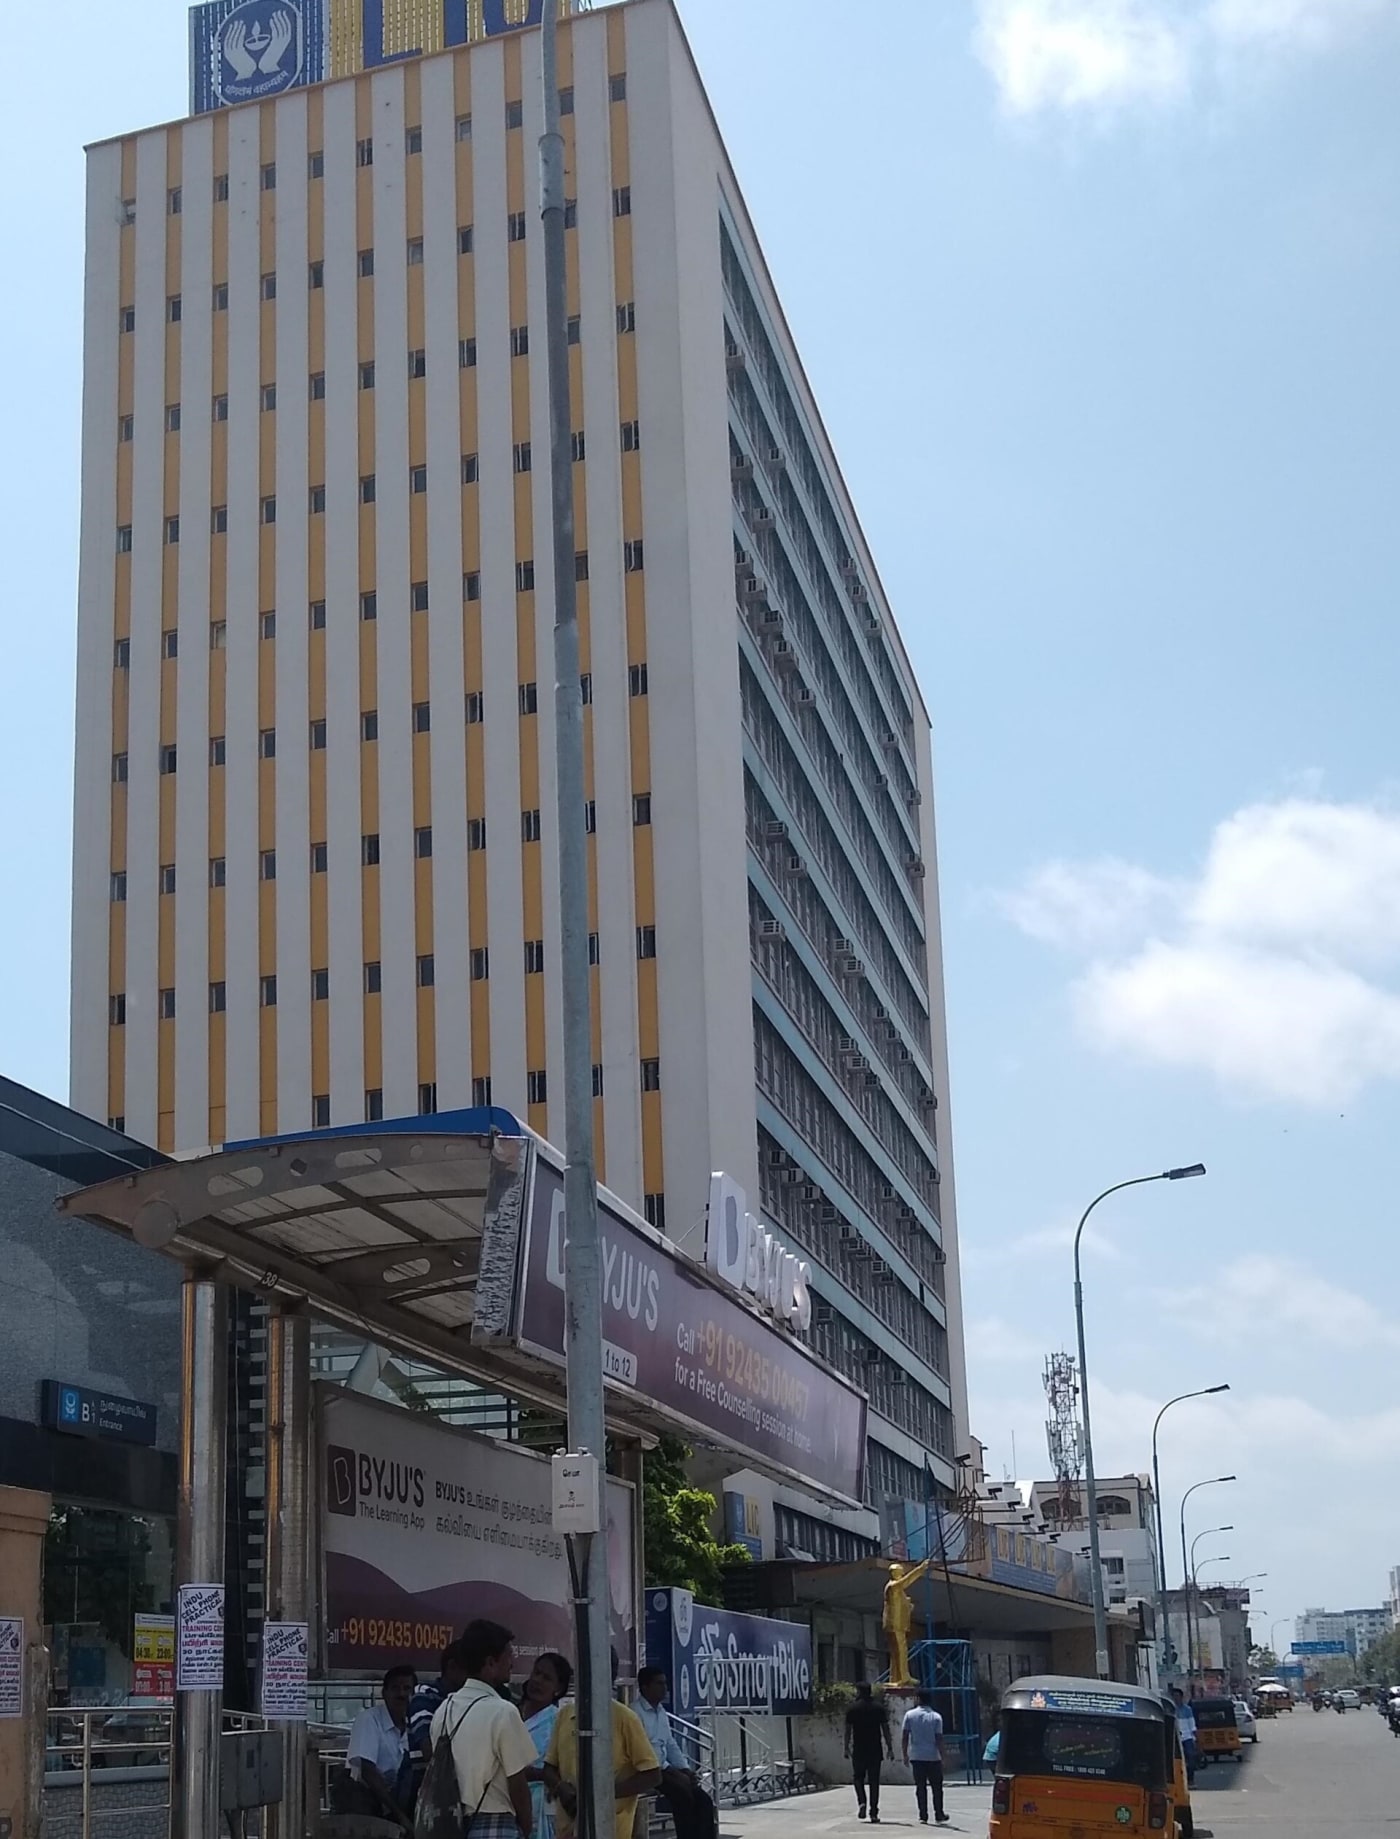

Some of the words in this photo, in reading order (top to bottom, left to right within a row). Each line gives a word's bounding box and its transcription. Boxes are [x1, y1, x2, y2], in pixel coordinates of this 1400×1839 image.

[601, 1236, 659, 1331] YJU'S
[605, 1349, 610, 1368] 1
[611, 1354, 620, 1372] to
[622, 1354, 631, 1378] 12
[677, 1322, 695, 1355] Call
[697, 1320, 723, 1372] +91
[726, 1334, 769, 1399] 92435
[772, 1364, 809, 1422] 00457
[82, 1402, 90, 1422] B
[674, 1356, 688, 1386] for
[689, 1371, 695, 1391] a
[696, 1368, 716, 1403] Free
[717, 1381, 760, 1432] Counselling
[761, 1411, 786, 1438] session
[786, 1423, 794, 1444] at
[99, 1417, 123, 1431] Entrance
[359, 1453, 424, 1508] BYJU'S
[435, 1480, 465, 1504] BYJU'S
[359, 1501, 374, 1518] The
[376, 1503, 409, 1529] Learning
[410, 1511, 425, 1530] App
[747, 1502, 759, 1537] LIC
[181, 1606, 199, 1619] CELL
[198, 1590, 220, 1608] PHONE
[183, 1591, 203, 1609] INDU
[265, 1642, 280, 1654] CELL
[280, 1628, 301, 1645] PHONE
[267, 1628, 284, 1645] INDU
[341, 1617, 364, 1645] +91
[368, 1619, 412, 1648] 92435
[415, 1623, 454, 1650] 00457
